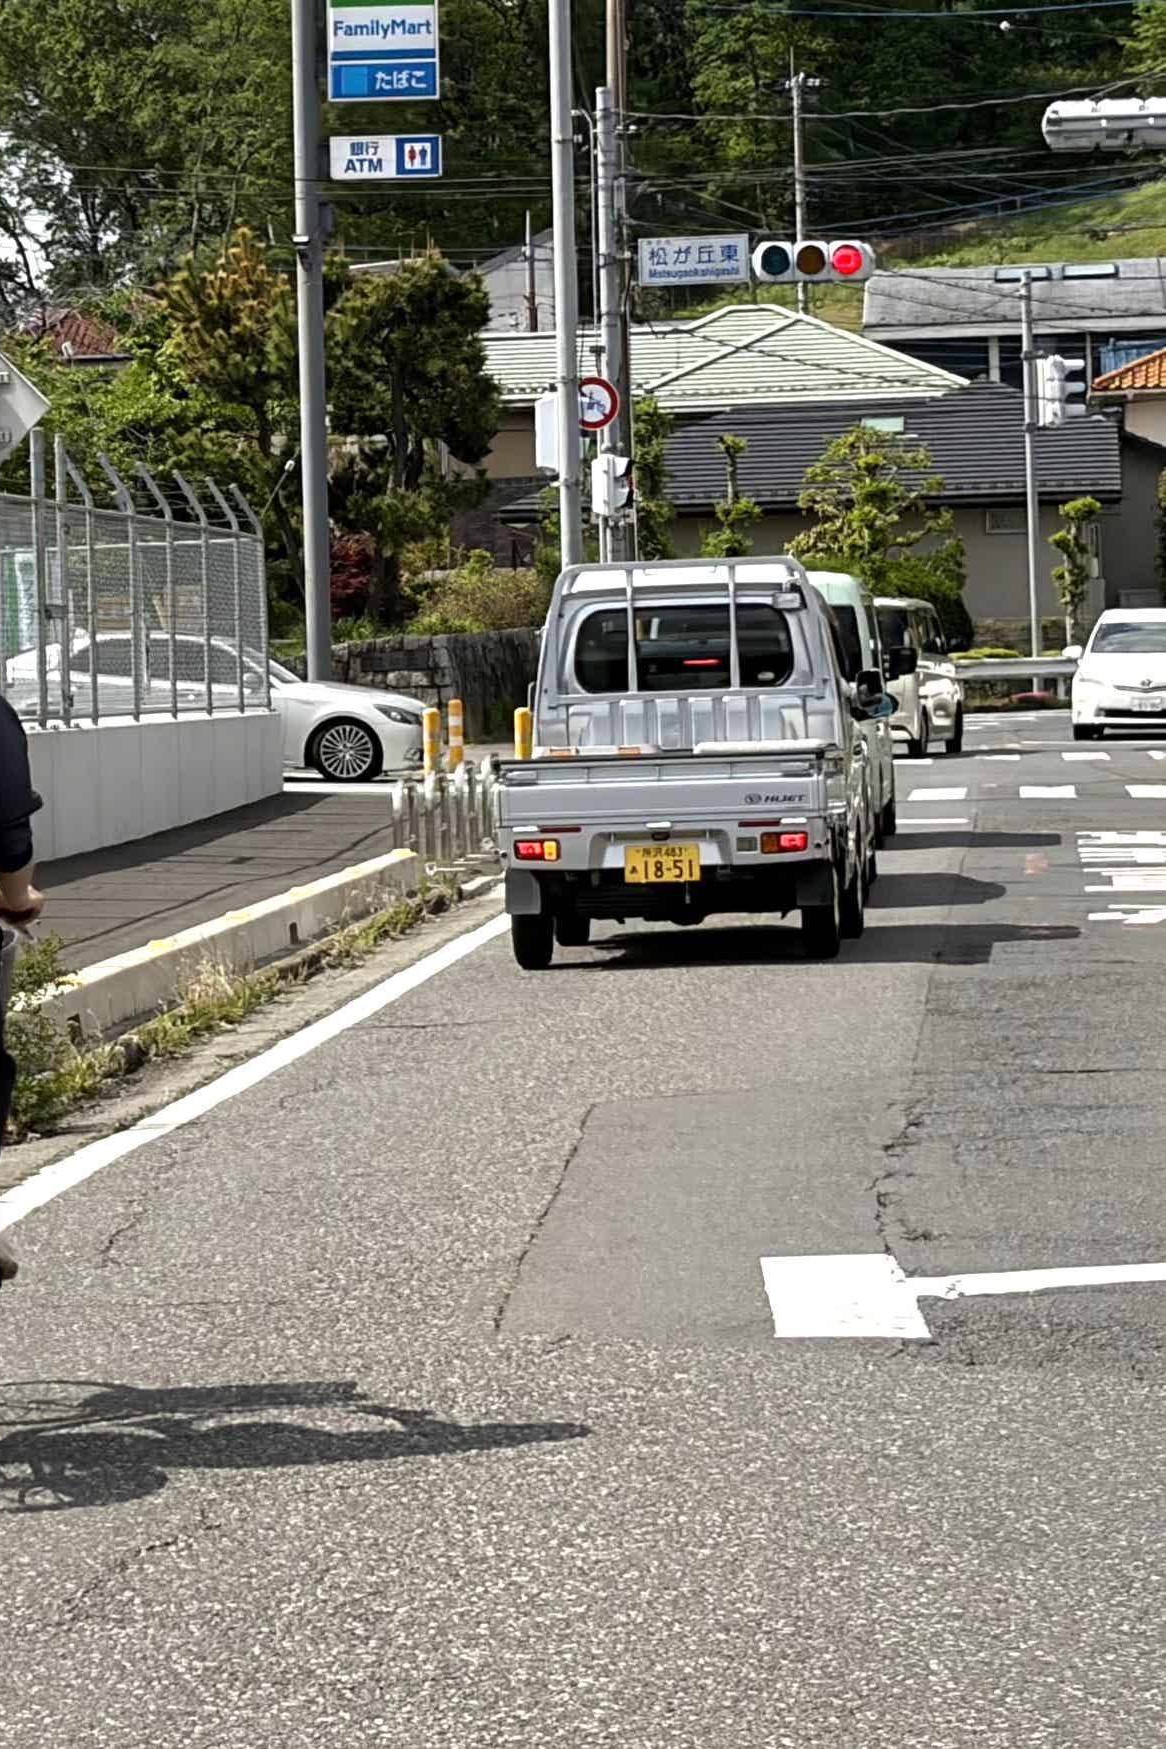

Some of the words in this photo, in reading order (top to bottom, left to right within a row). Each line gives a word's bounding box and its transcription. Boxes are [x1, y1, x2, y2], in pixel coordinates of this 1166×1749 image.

[333, 19, 432, 39] FamilyMart
[375, 70, 427, 90] たばこ
[349, 141, 379, 156] 銀行
[344, 158, 383, 173] ATM
[644, 859, 693, 880] 18-51
